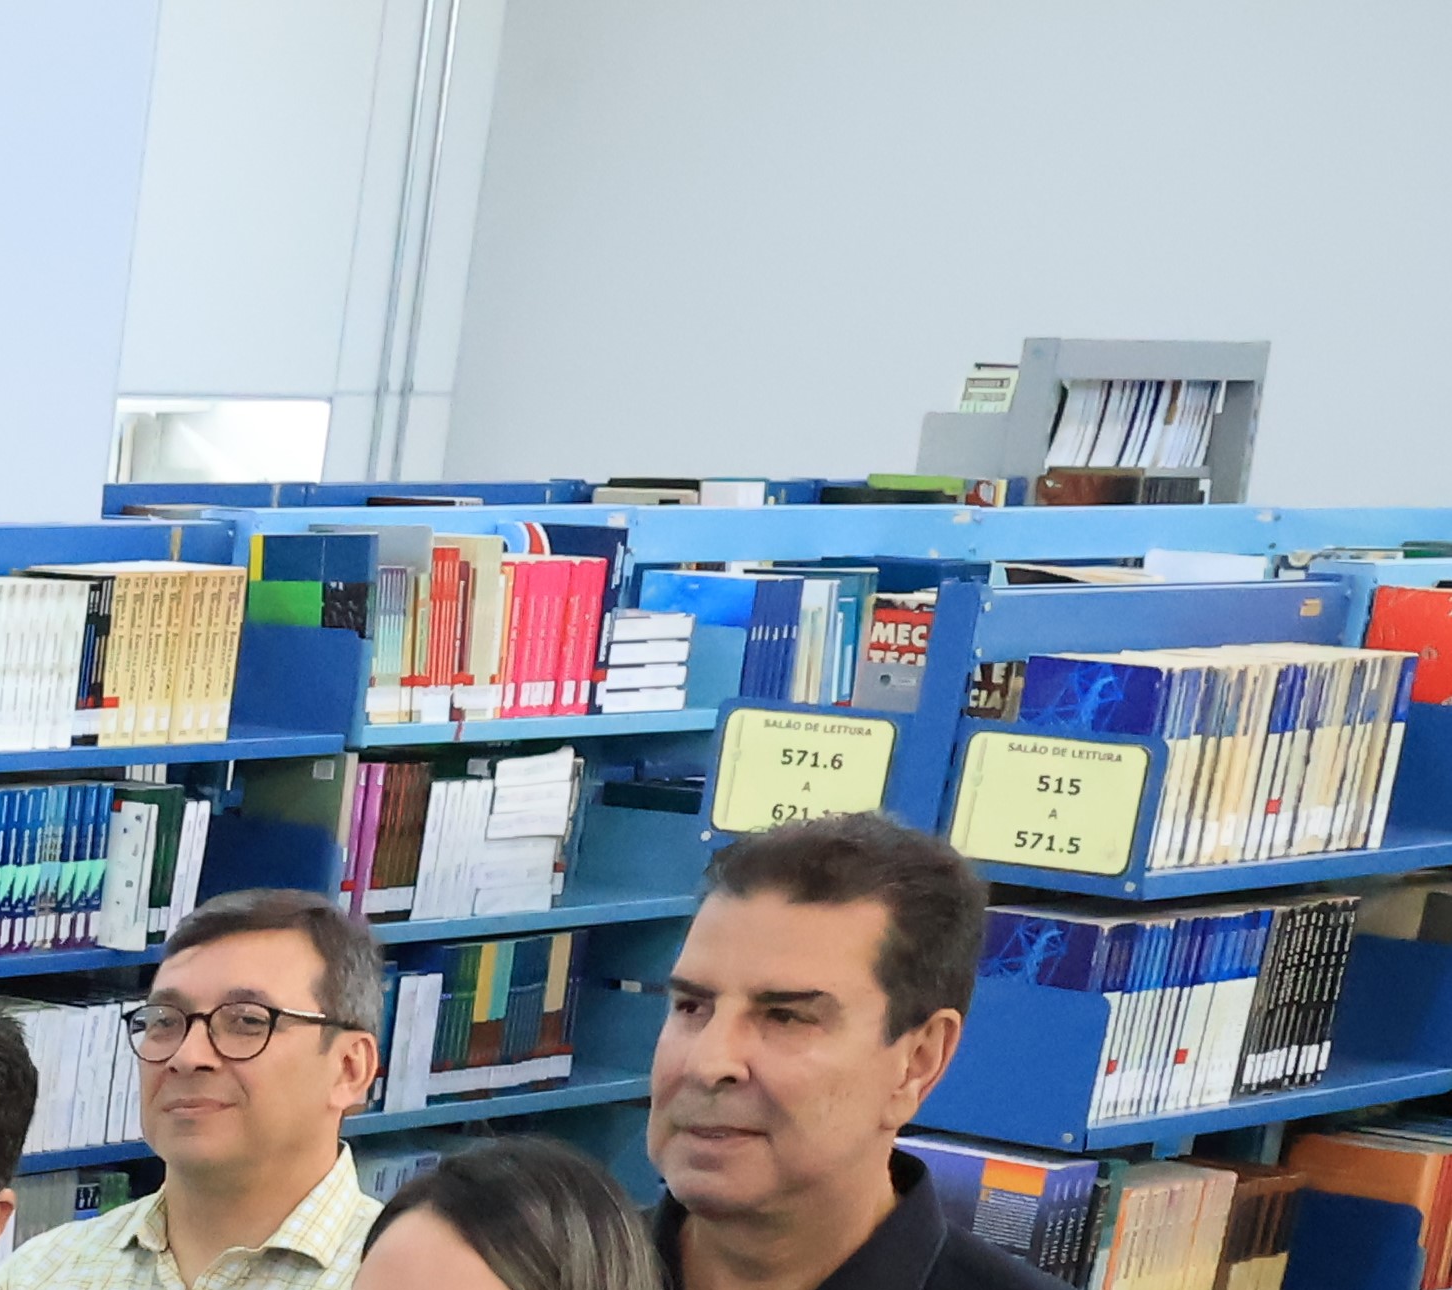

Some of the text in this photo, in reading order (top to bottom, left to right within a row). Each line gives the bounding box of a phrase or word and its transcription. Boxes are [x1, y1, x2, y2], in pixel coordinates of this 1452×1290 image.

[764, 718, 872, 737] SALÃO DE LEITURA
[780, 748, 844, 770] 571.6
[1008, 742, 1123, 763] SALÃO DE LEITURA
[801, 781, 811, 792] A
[1036, 774, 1082, 796] 515
[1048, 808, 1058, 819] A
[1014, 830, 1082, 855] 571.5
